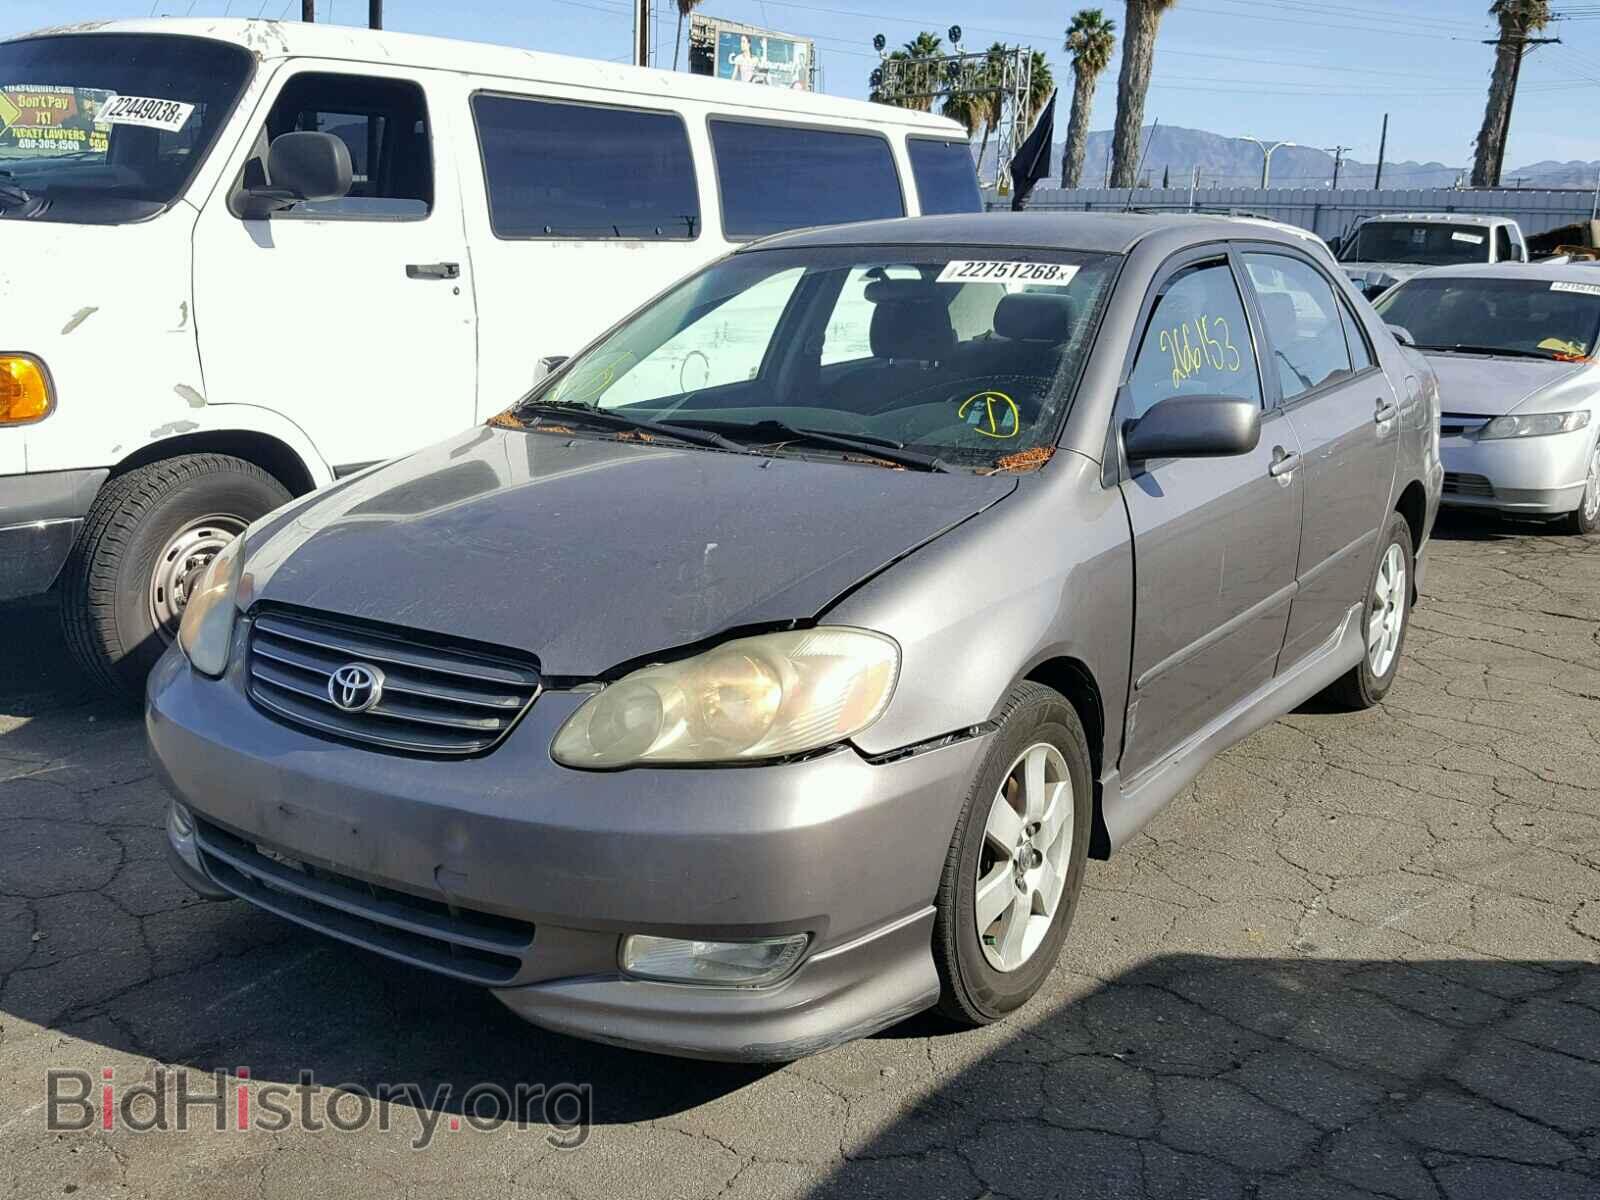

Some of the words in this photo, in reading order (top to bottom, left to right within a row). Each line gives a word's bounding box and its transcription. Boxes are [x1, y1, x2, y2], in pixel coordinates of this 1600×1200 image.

[18, 95, 46, 108] Don't
[48, 95, 69, 110] Pay
[12, 127, 44, 139] TICKET
[44, 129, 86, 141] LAWYERS
